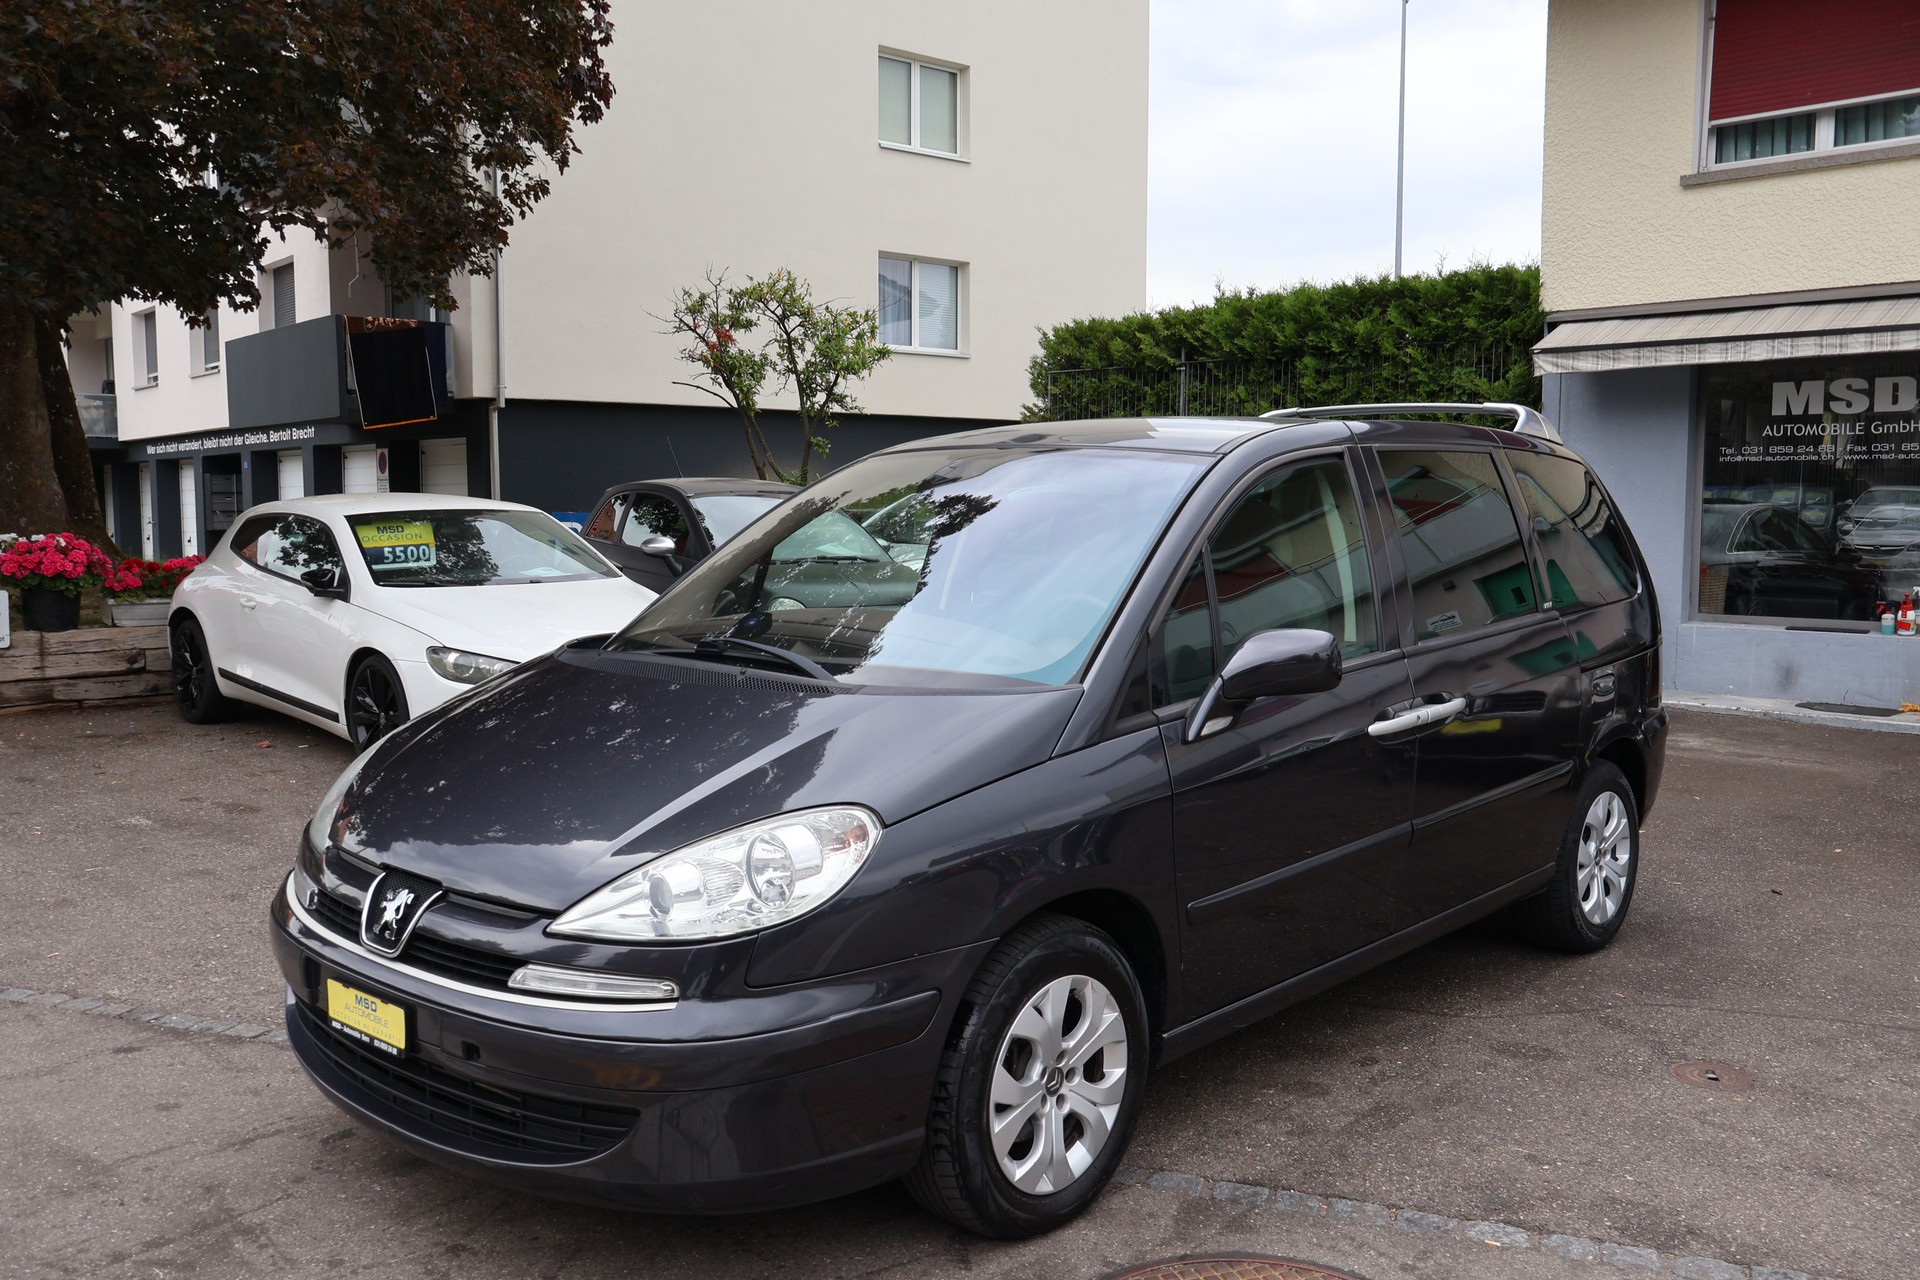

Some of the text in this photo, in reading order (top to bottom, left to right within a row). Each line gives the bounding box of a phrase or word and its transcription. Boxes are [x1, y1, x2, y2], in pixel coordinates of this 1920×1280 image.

[1771, 376, 1917, 416] MSD
[1762, 420, 1920, 437] AUTOMOBILE GmbH
[146, 445, 156, 454] Wer
[156, 443, 166, 453] sich
[166, 441, 178, 452] nicht
[203, 436, 219, 449] bleibt
[219, 435, 233, 446] nicht
[234, 434, 244, 446] der
[269, 428, 291, 442] Bertolt
[292, 425, 315, 440] Brecht
[1719, 446, 1738, 455] Tel.
[1741, 446, 1764, 454] 031
[1768, 445, 1794, 454] 859
[1797, 445, 1814, 453] 24
[1818, 444, 1835, 452] 88
[1846, 443, 1868, 452] Fax
[1871, 443, 1895, 452] 031
[1719, 454, 1834, 463] info@msd-automobile.ch
[361, 533, 423, 543] OCCASION
[376, 525, 405, 535] MSD
[383, 545, 430, 563] 5500
[355, 994, 378, 1013] MSD
[344, 1003, 390, 1029] AUTOMOBILE
